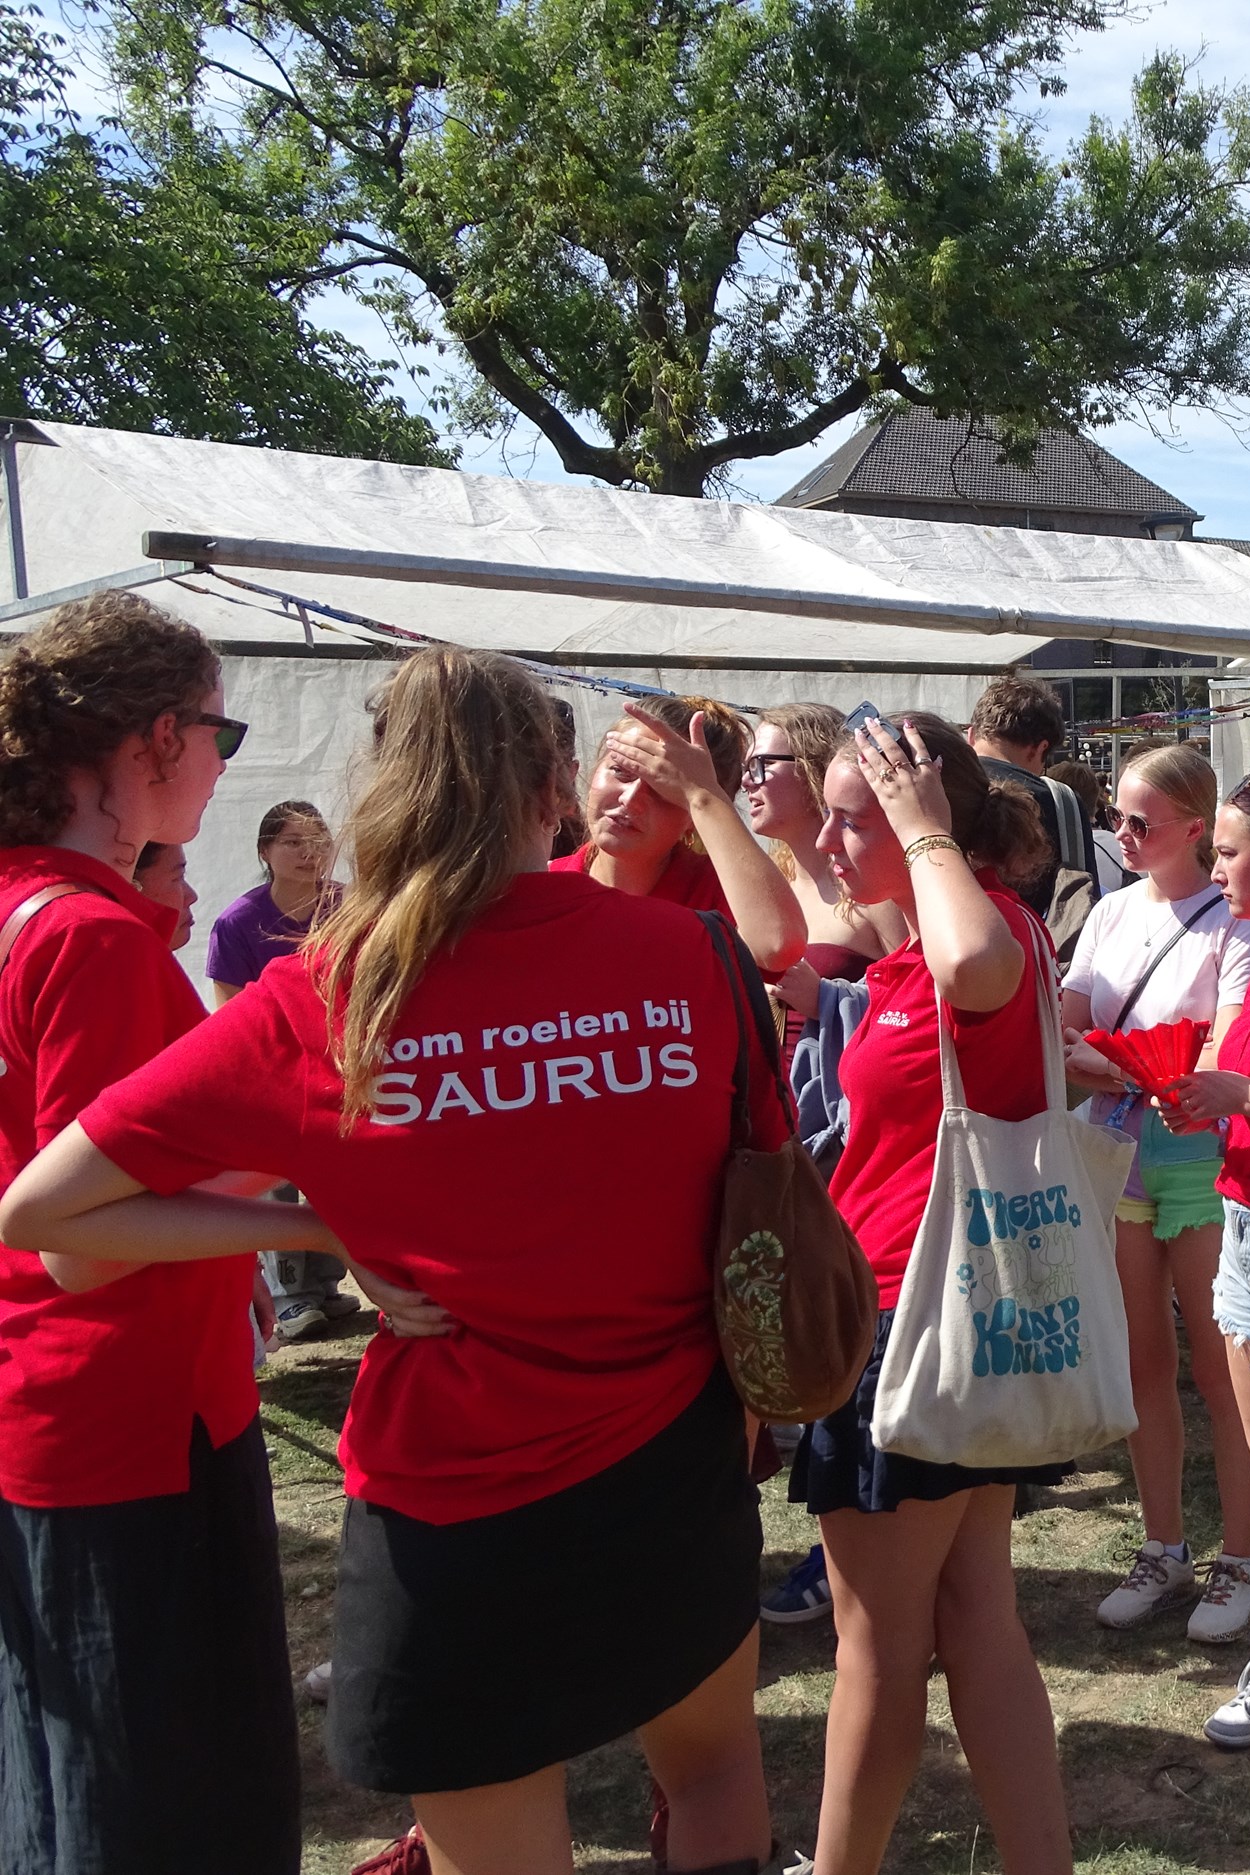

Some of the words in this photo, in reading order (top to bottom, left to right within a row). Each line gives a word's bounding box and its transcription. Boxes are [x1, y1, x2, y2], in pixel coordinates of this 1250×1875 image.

[482, 1011, 630, 1050] roeien
[643, 1000, 692, 1035] bij
[369, 1043, 698, 1125] SAURUS
